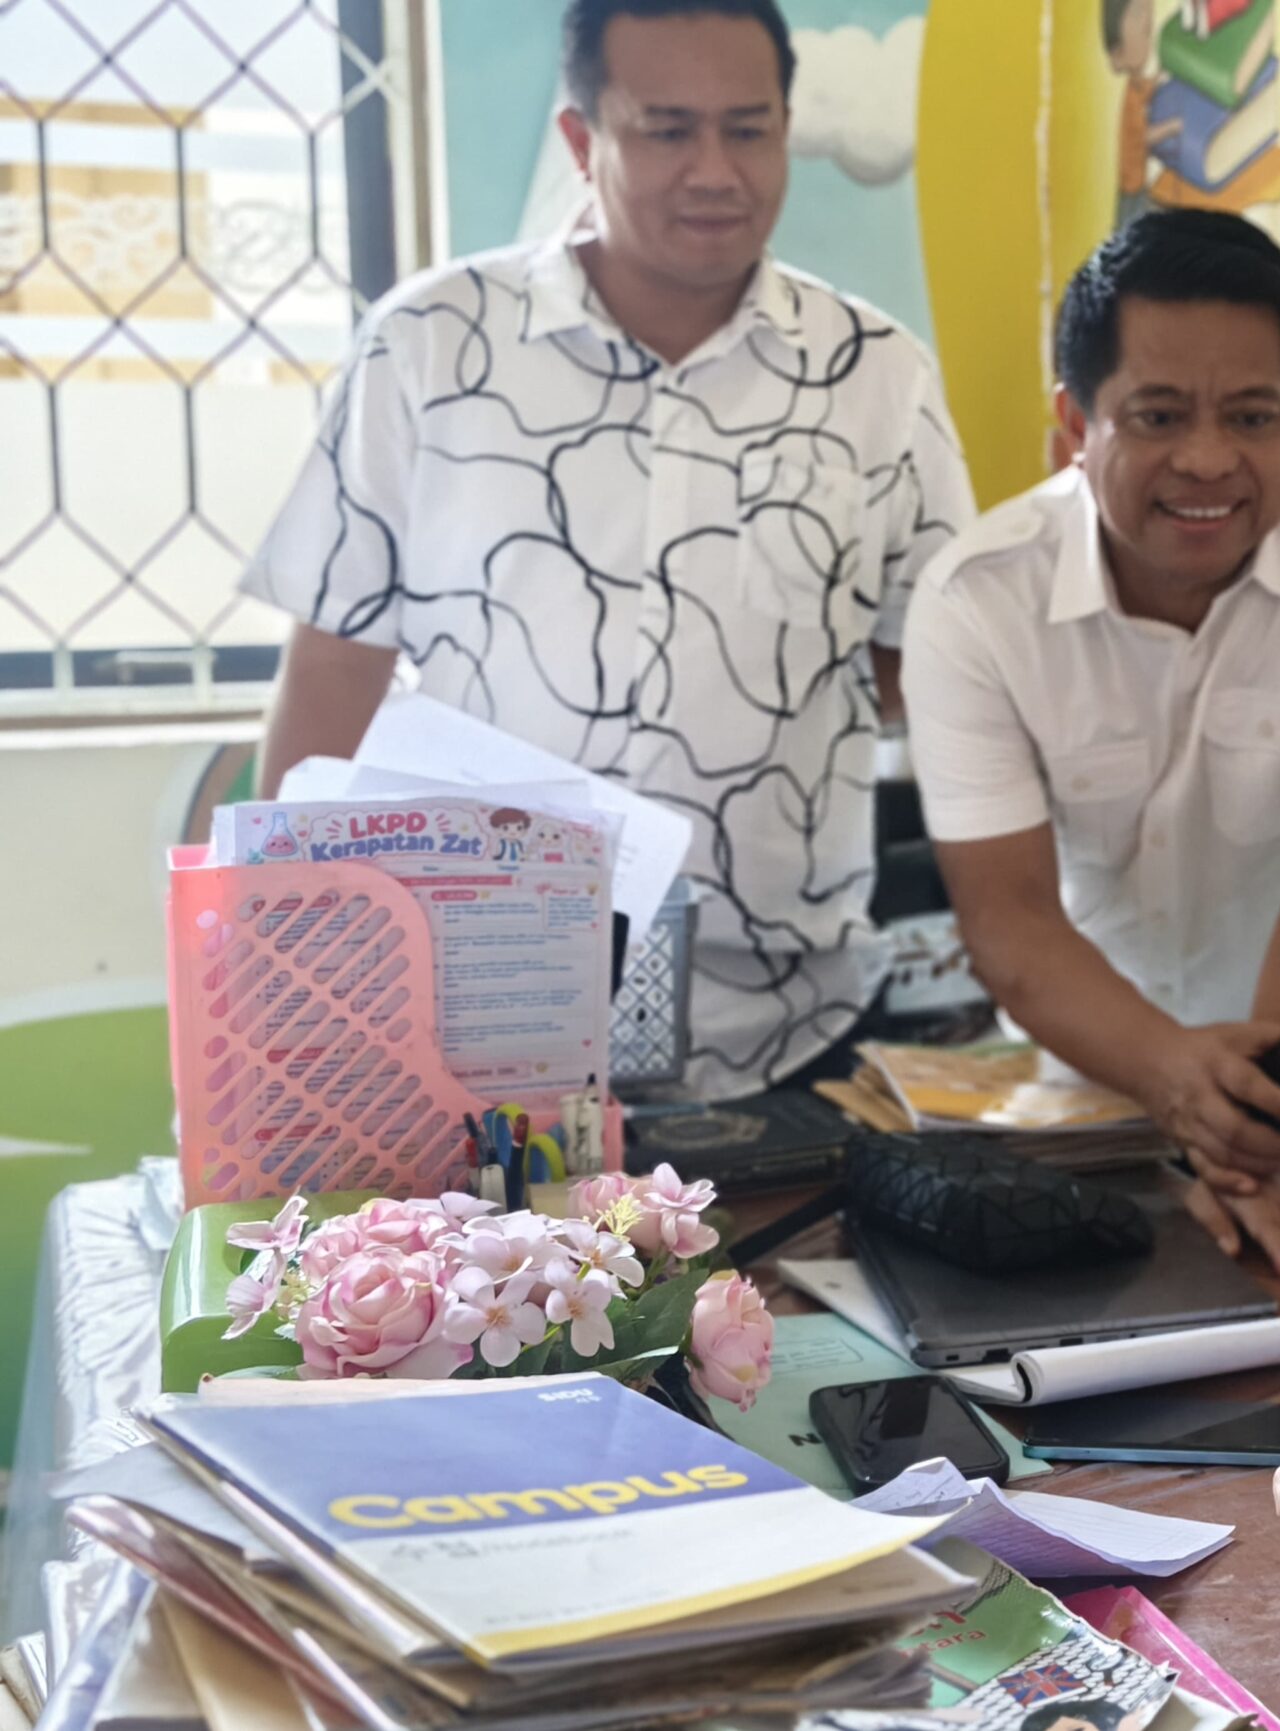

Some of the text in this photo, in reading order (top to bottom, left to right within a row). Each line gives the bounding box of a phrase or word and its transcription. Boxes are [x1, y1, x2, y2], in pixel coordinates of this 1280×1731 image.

[349, 811, 427, 839] LKPD
[310, 833, 483, 862] Kerapatan Zat
[329, 1464, 749, 1529] Campus
